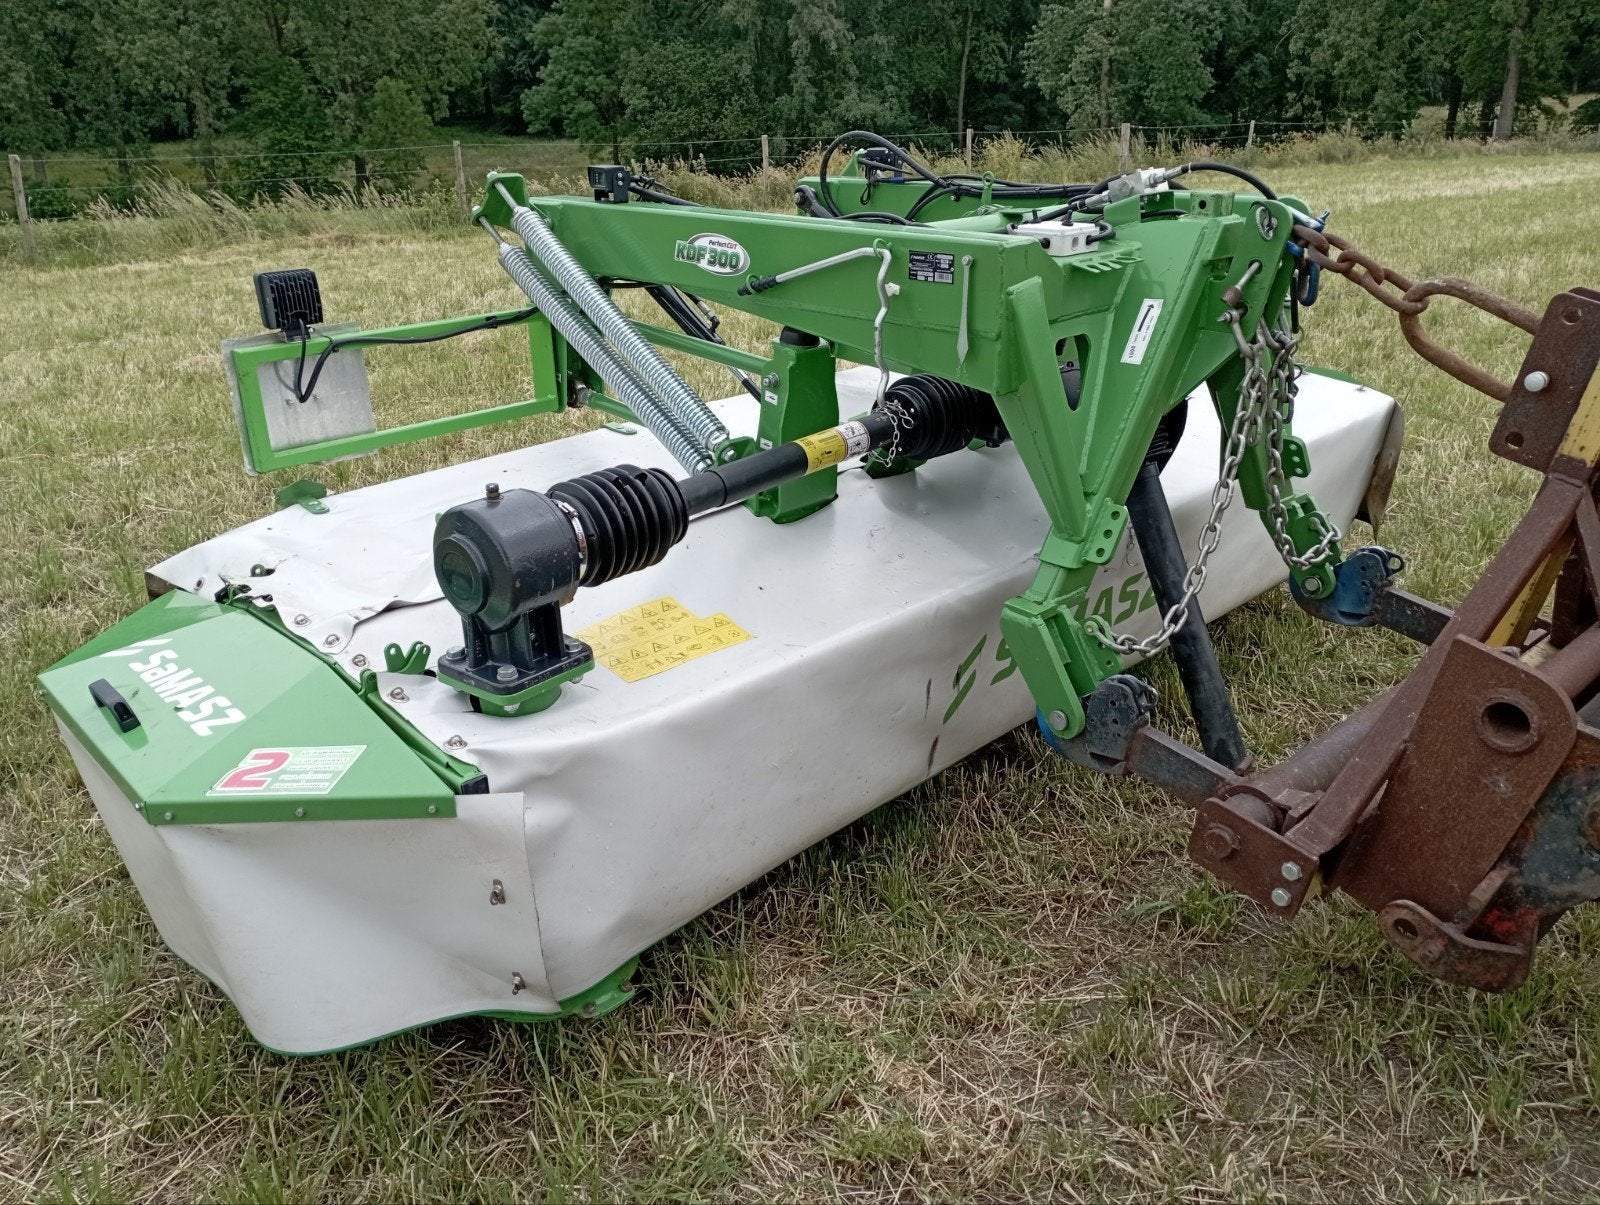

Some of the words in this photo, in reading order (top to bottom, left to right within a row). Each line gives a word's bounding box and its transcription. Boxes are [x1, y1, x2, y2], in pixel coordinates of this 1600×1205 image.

[707, 246, 741, 271] 300
[127, 649, 248, 737] SaMASZ
[219, 751, 291, 789] 2
